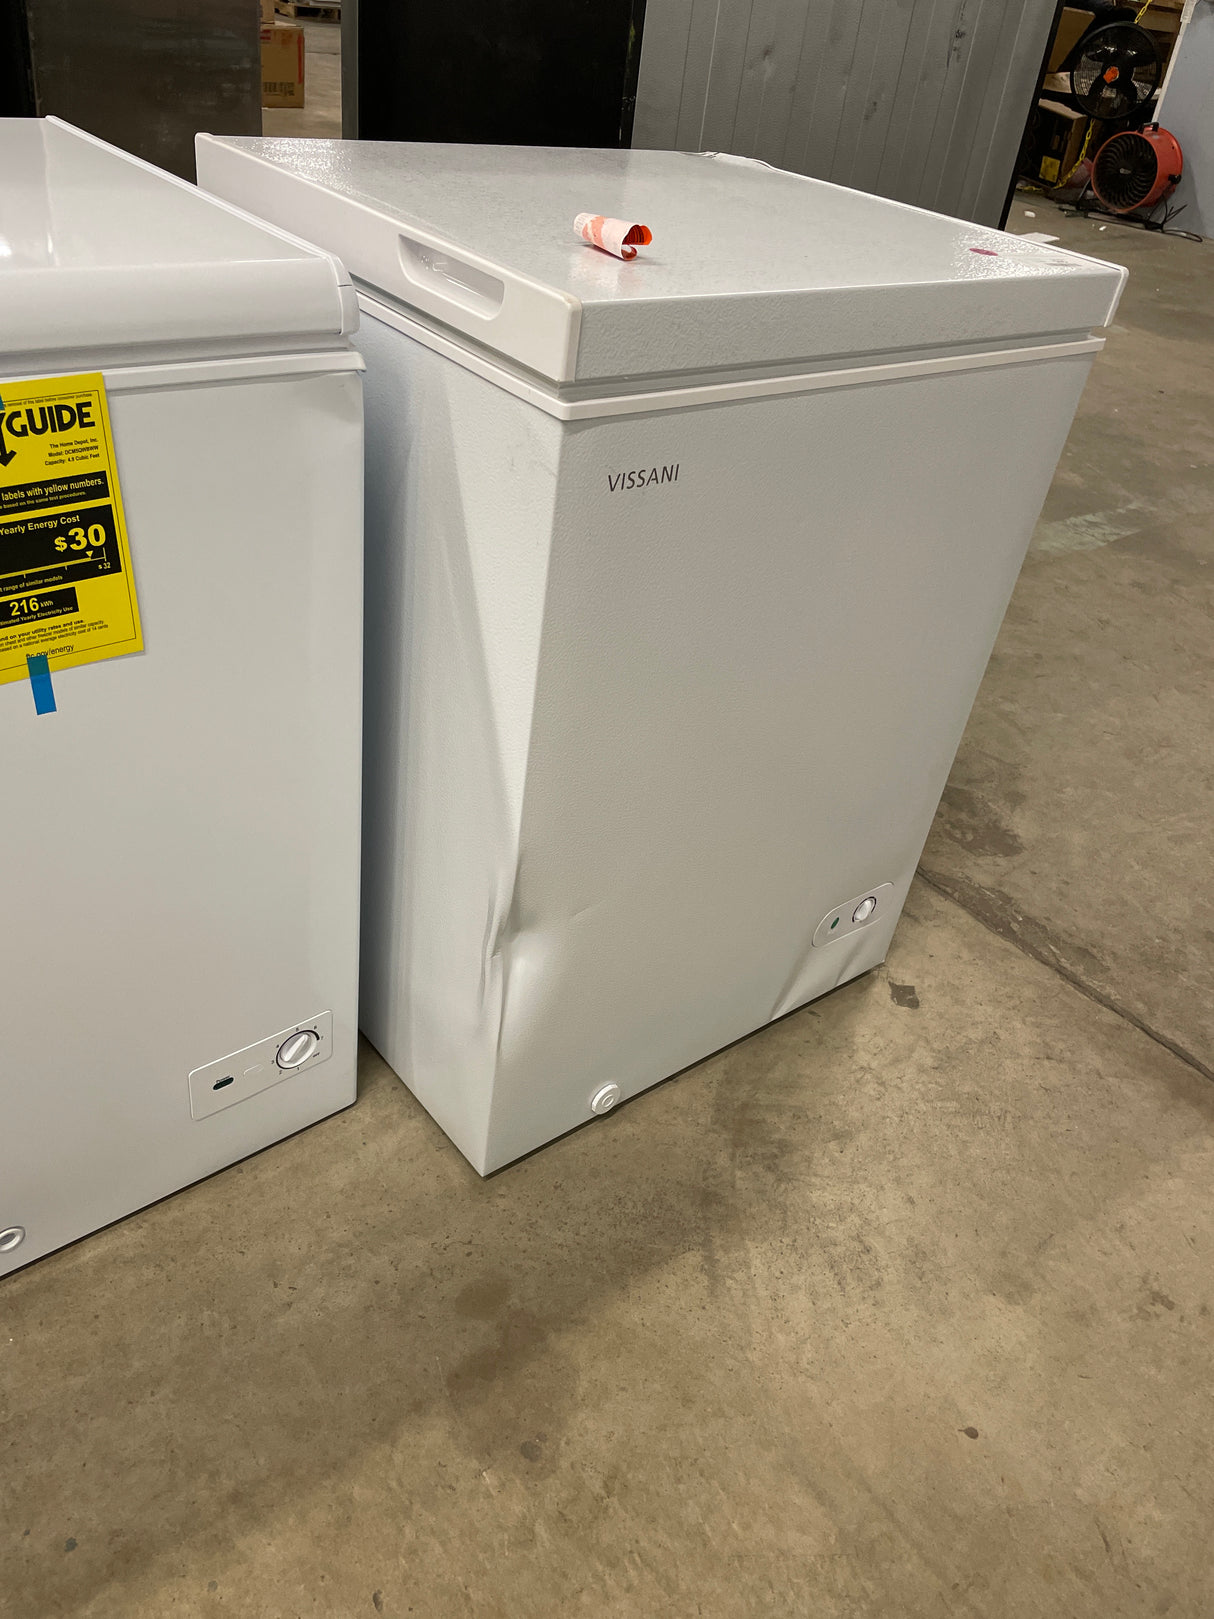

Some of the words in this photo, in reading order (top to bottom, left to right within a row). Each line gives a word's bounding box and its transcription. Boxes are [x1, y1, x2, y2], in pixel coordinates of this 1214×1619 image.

[608, 463, 679, 492] VISSANI
[1, 490, 25, 501] labels
[26, 488, 43, 497] with
[44, 484, 68, 496] yellow
[0, 524, 25, 536] Yearly
[27, 520, 58, 531] Energy
[60, 515, 81, 524] Cost
[54, 523, 106, 552] $30
[44, 575, 63, 583] models
[10, 597, 39, 616] 216
[40, 600, 54, 608] kWh
[0, 618, 19, 626] timated
[37, 608, 62, 618] Electricity
